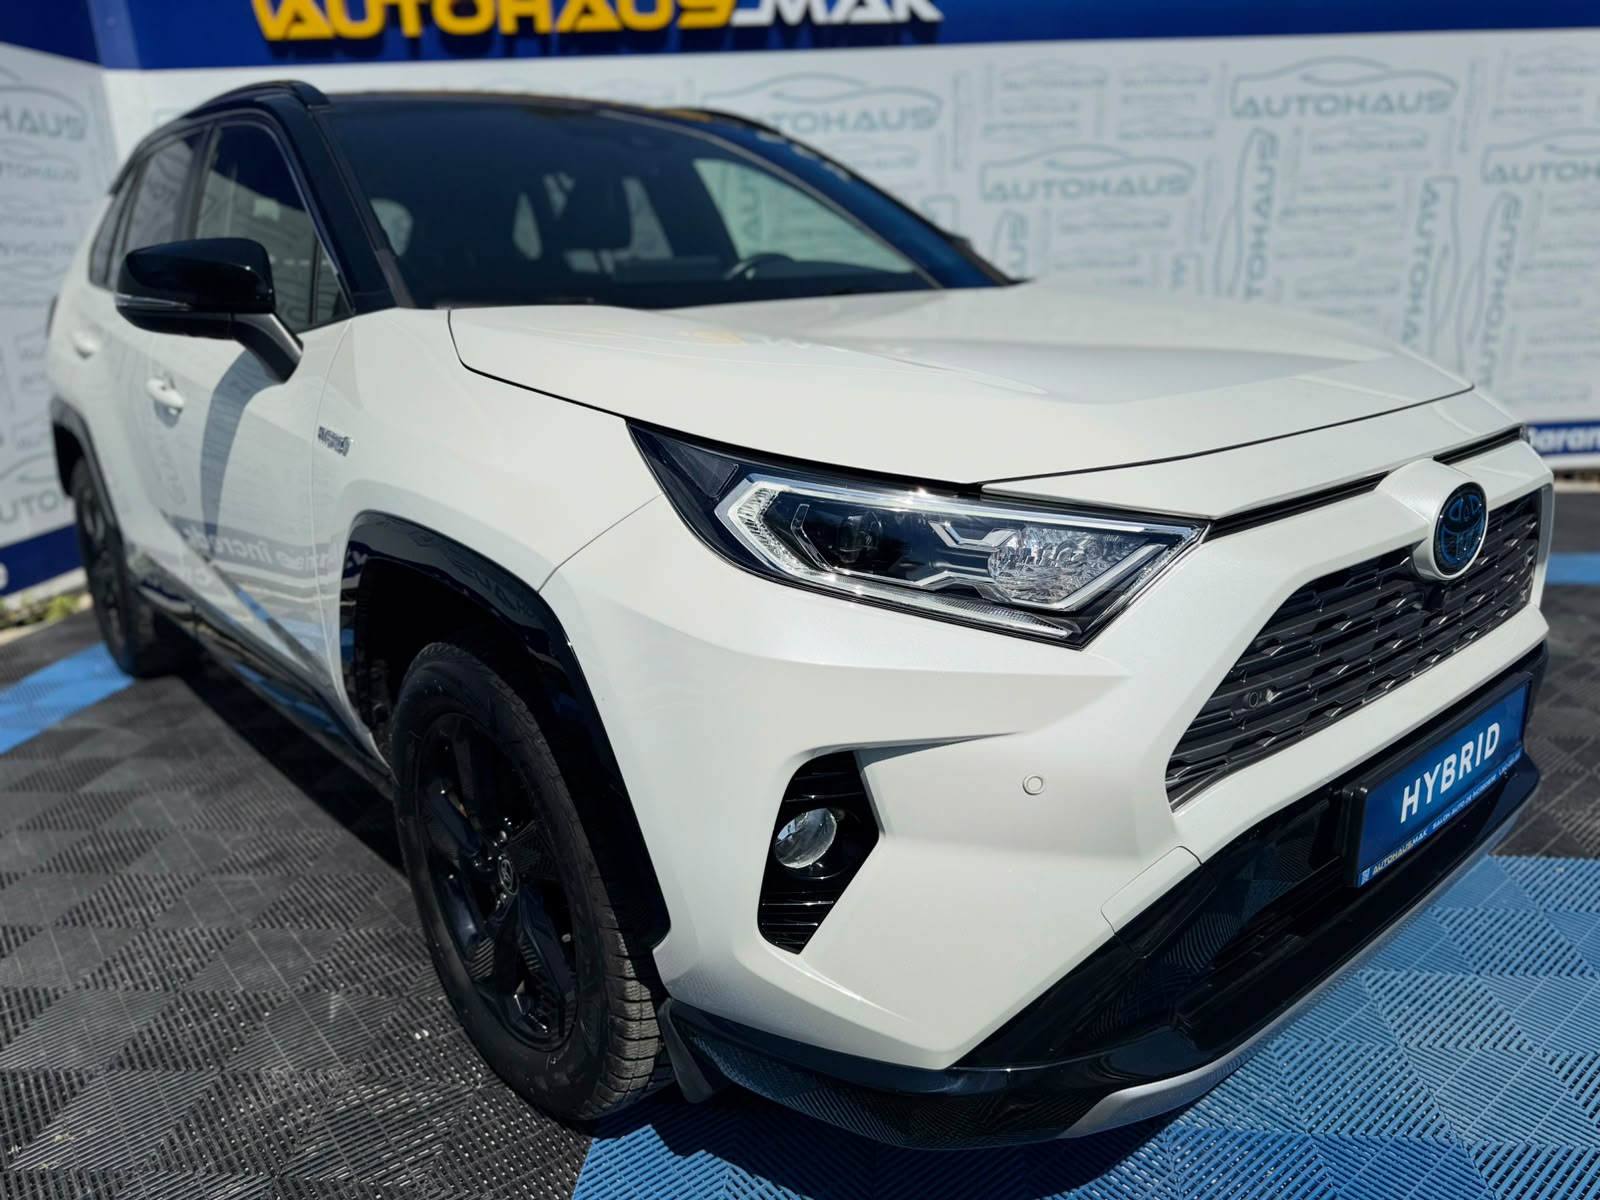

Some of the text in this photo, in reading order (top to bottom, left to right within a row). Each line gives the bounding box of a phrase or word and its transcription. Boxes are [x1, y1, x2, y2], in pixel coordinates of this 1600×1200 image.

[1234, 91, 1451, 118] AUTOHAUS
[984, 174, 1191, 203] AUTOHAUS
[1400, 722, 1500, 824] HYBRID
